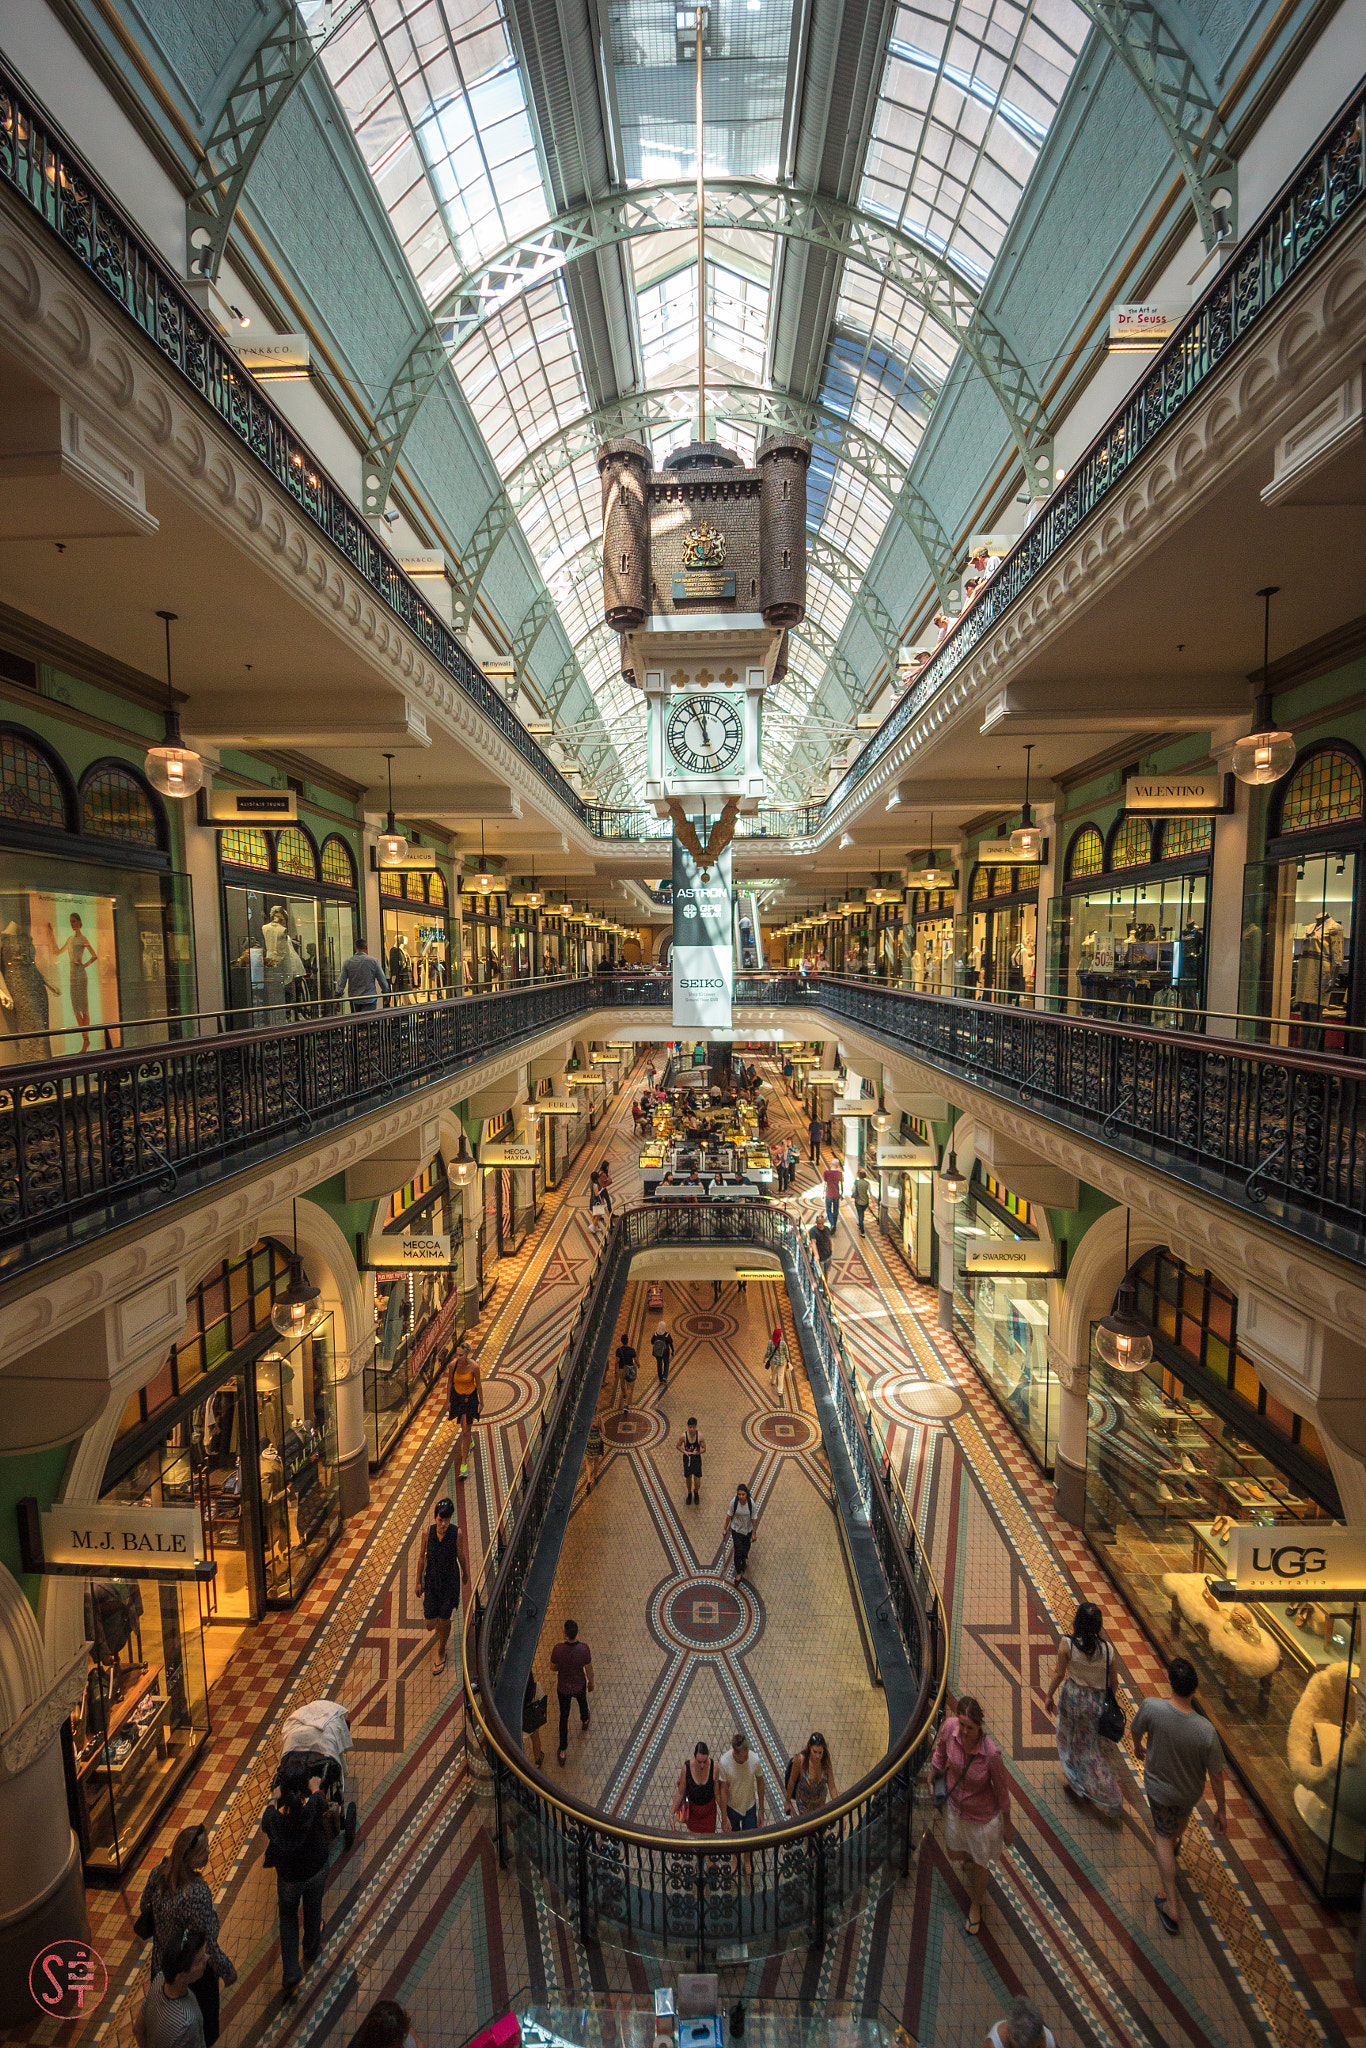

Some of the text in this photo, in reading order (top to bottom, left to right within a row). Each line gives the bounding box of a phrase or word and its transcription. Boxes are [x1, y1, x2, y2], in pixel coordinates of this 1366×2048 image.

[1118, 314, 1166, 324] Dr. Seuss
[1135, 786, 1204, 797] VALENTINO
[676, 888, 727, 898] ASTRON
[700, 904, 722, 912] GPS
[680, 978, 724, 988] SEIKO
[403, 1240, 440, 1250] MECCA
[404, 1250, 444, 1258] MAXIMA
[71, 1531, 187, 1552] M.J. BALE
[1252, 1546, 1327, 1578] UGG
